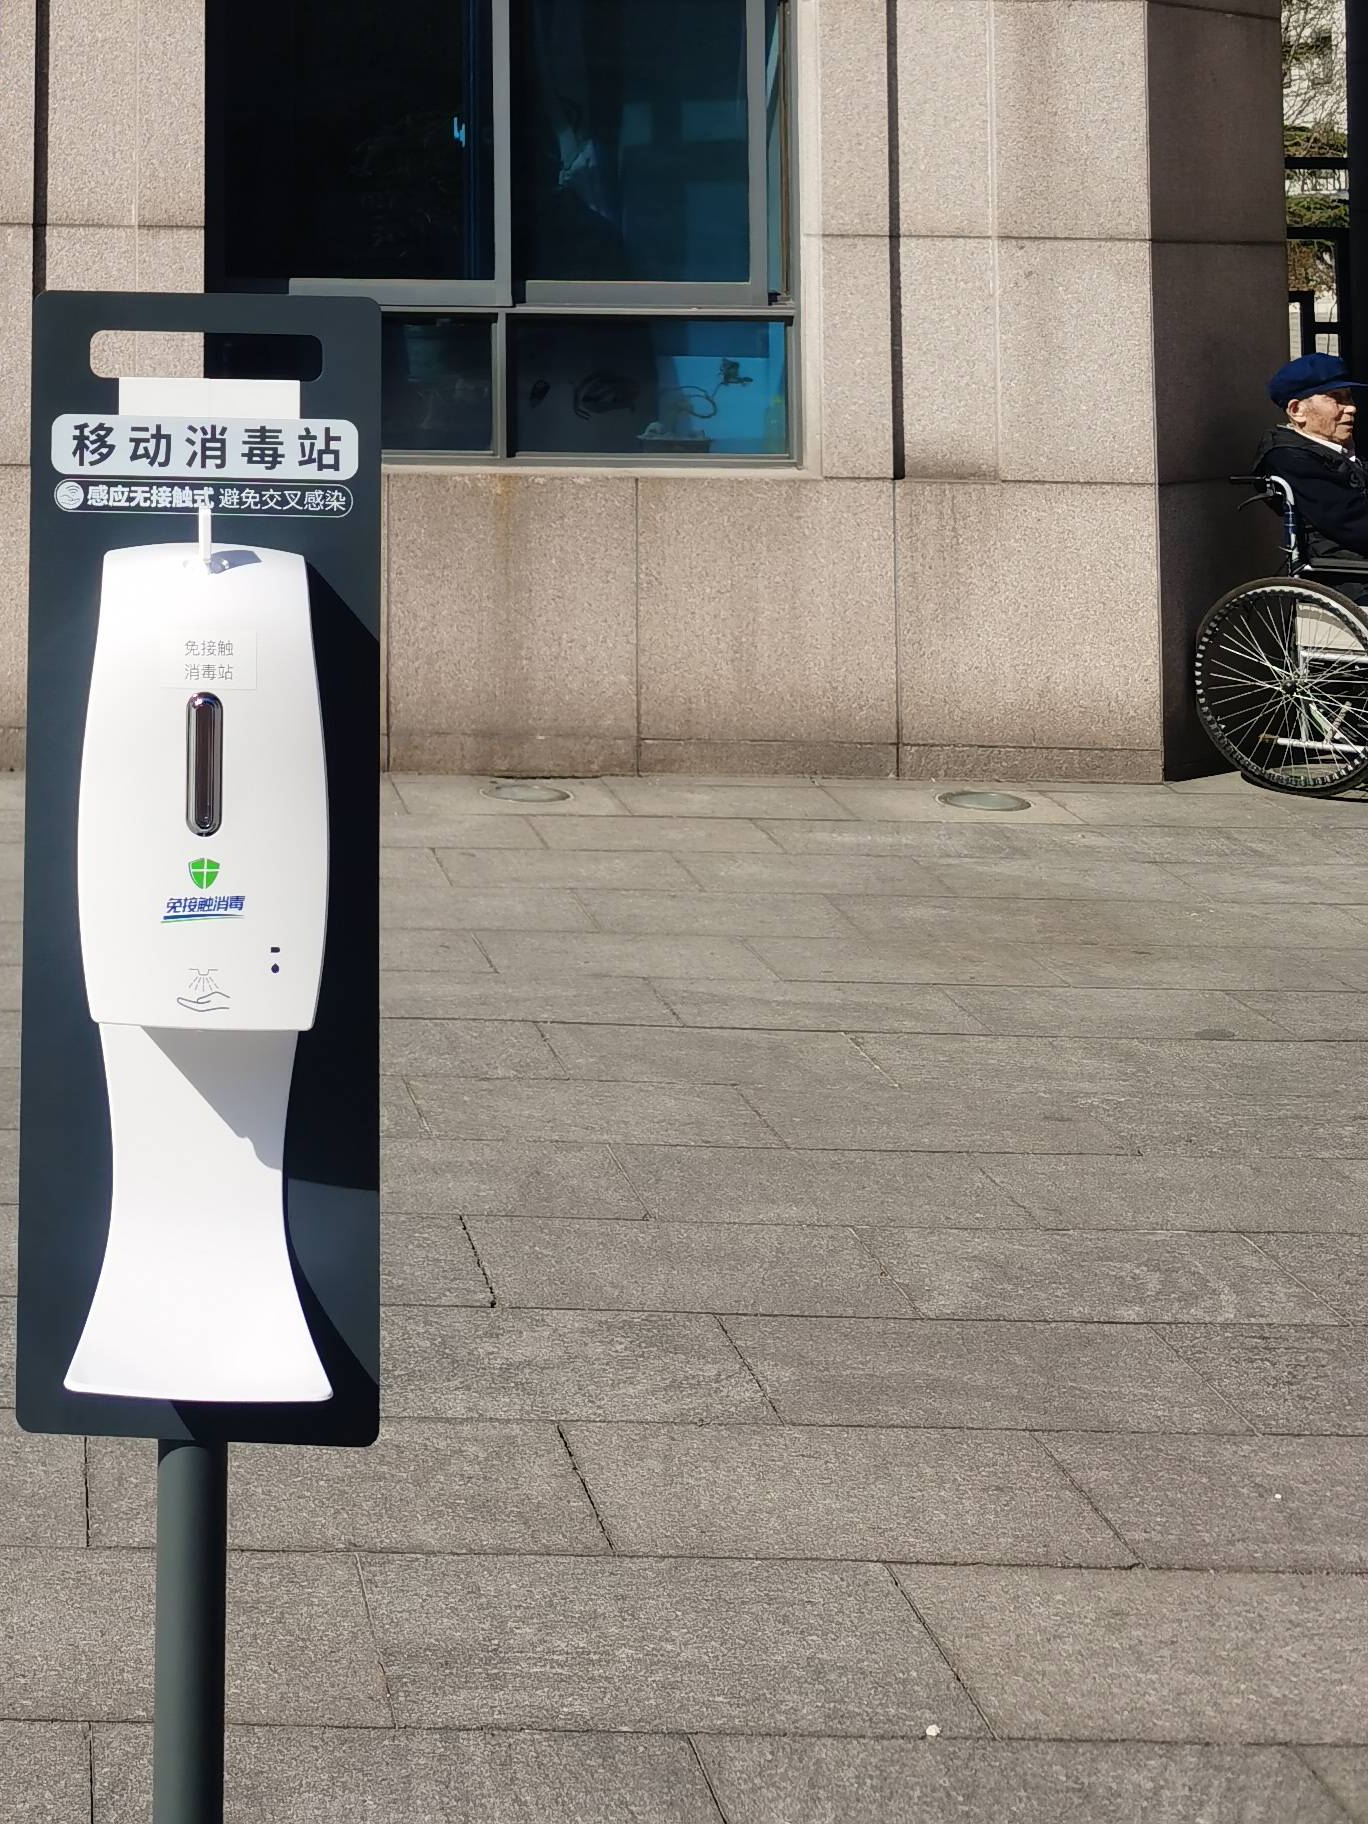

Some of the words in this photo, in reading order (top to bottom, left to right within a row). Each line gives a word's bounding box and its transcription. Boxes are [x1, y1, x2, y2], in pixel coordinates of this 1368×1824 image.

[71, 421, 343, 472] 移动消毒站
[86, 484, 216, 509] 感应无接触式
[218, 487, 347, 512] 避免交叉感染
[184, 639, 234, 658] 免接触
[184, 663, 234, 681] 消毒站
[165, 895, 246, 914] 免接触消毒
